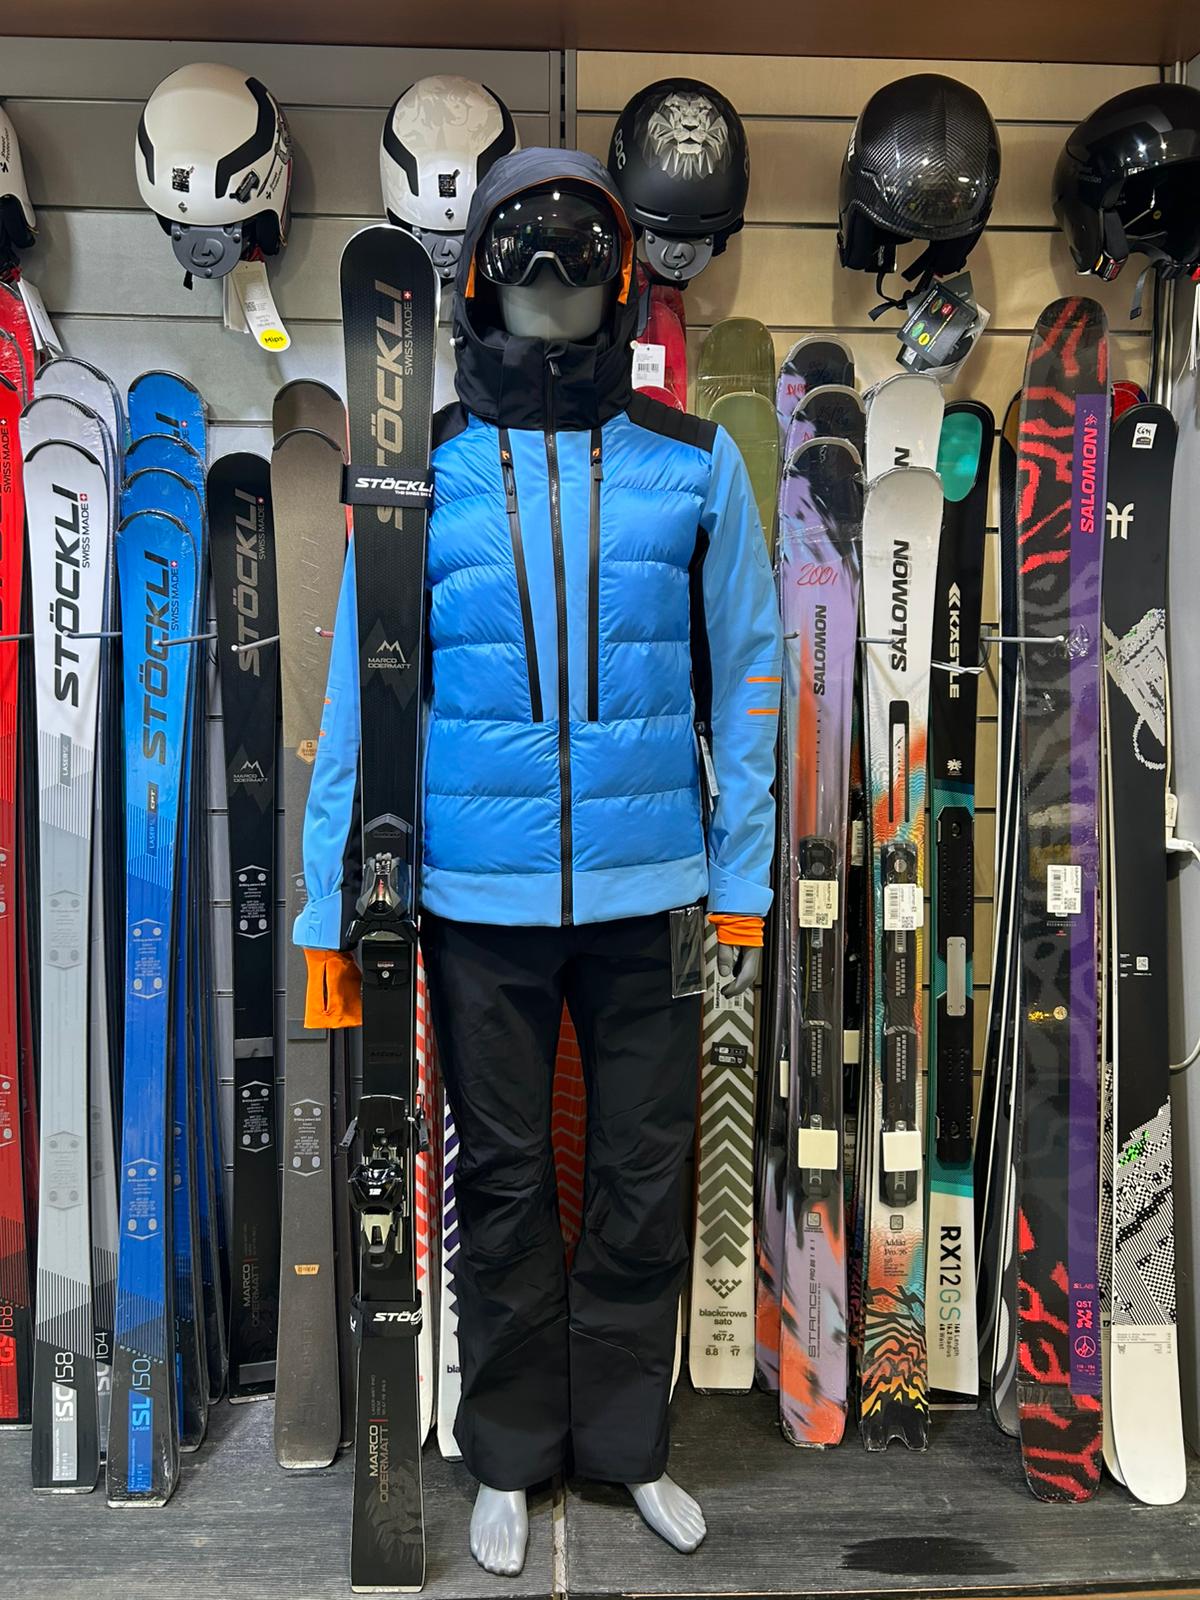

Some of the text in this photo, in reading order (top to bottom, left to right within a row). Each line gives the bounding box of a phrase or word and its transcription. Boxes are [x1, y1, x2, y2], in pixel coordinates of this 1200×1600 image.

[264, 335, 285, 344] Mips
[404, 301, 413, 376] SWISS MADE
[2, 428, 12, 493] SWISS MADE
[1080, 429, 1098, 534] SALOMON
[81, 502, 91, 568] SWISS MADE
[257, 504, 267, 560] SWISS MADE
[49, 483, 80, 707] STÖCKLI
[170, 568, 180, 631] SWISS MADE
[233, 488, 261, 678] STÖCKLI
[891, 540, 910, 672] SALOMON
[137, 550, 170, 766] STÖCKLI
[813, 605, 827, 696] SALOMON
[242, 1263, 252, 1307] MARCO
[698, 1308, 748, 1318] blackcrows
[1075, 1300, 1093, 1309] QST
[705, 1347, 719, 1357] 8.8
[712, 1333, 735, 1342] 167.2
[713, 1318, 733, 1326] sato
[729, 1347, 741, 1357] 17
[808, 1282, 818, 1358] STANCE
[946, 1336, 954, 1358] Radius
[952, 1334, 961, 1357] Length
[55, 1352, 74, 1417] SC 158
[132, 1359, 151, 1426] SL 150
[369, 1424, 379, 1478] MARCO
[379, 1426, 390, 1504] ODERMATT
